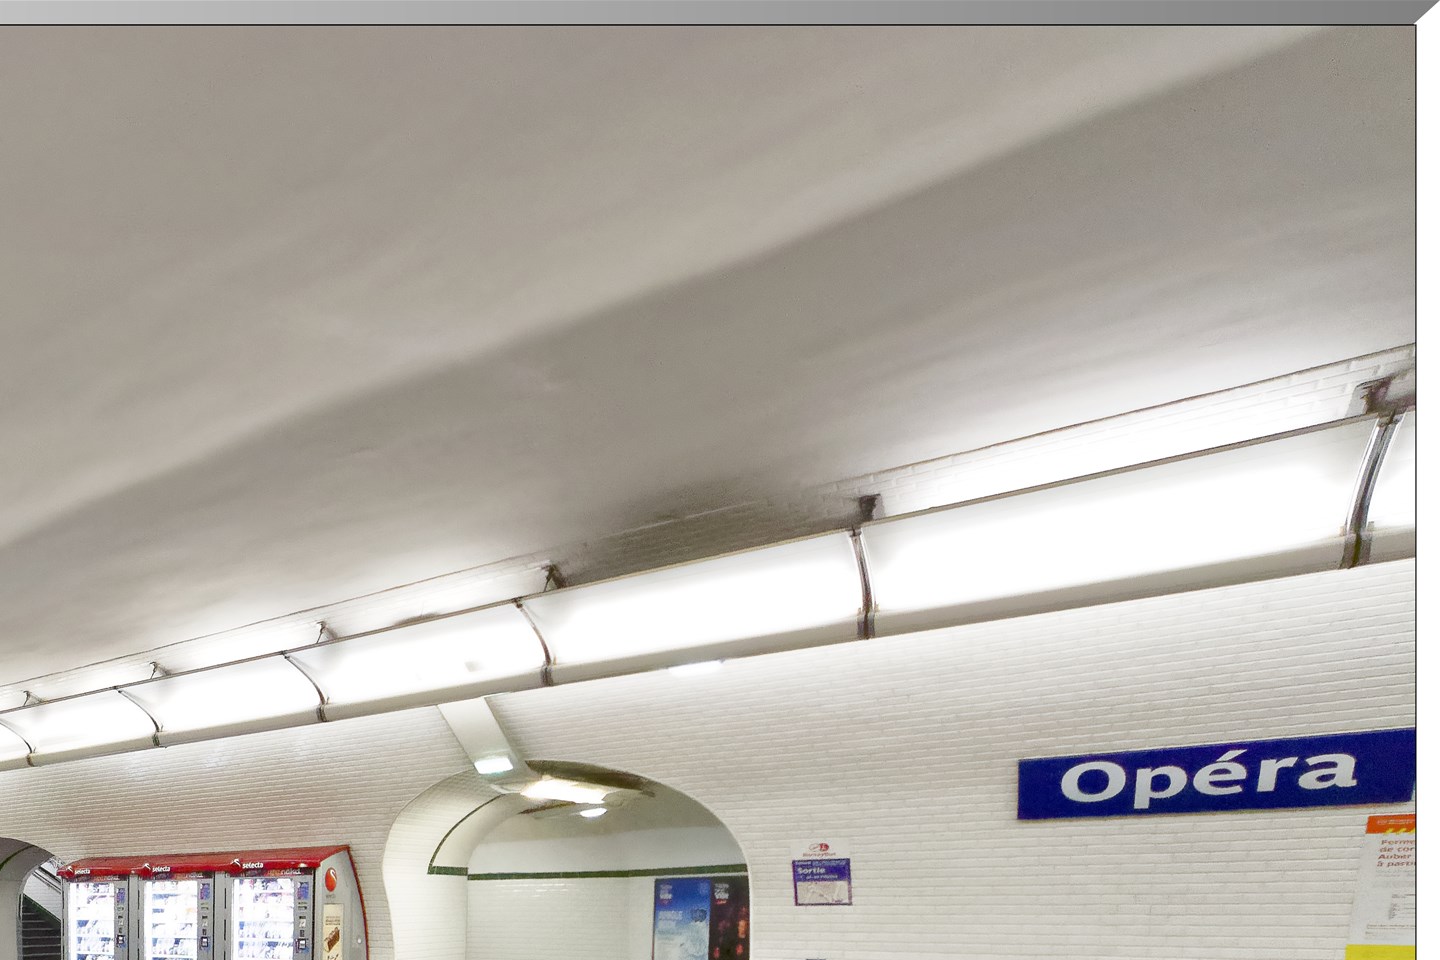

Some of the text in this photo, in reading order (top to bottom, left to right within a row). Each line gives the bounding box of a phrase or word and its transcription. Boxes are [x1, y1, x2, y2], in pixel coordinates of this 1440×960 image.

[1060, 749, 1358, 809] Opéra
[152, 865, 171, 873] selecta
[242, 861, 264, 869] selecta
[74, 867, 91, 875] selecta
